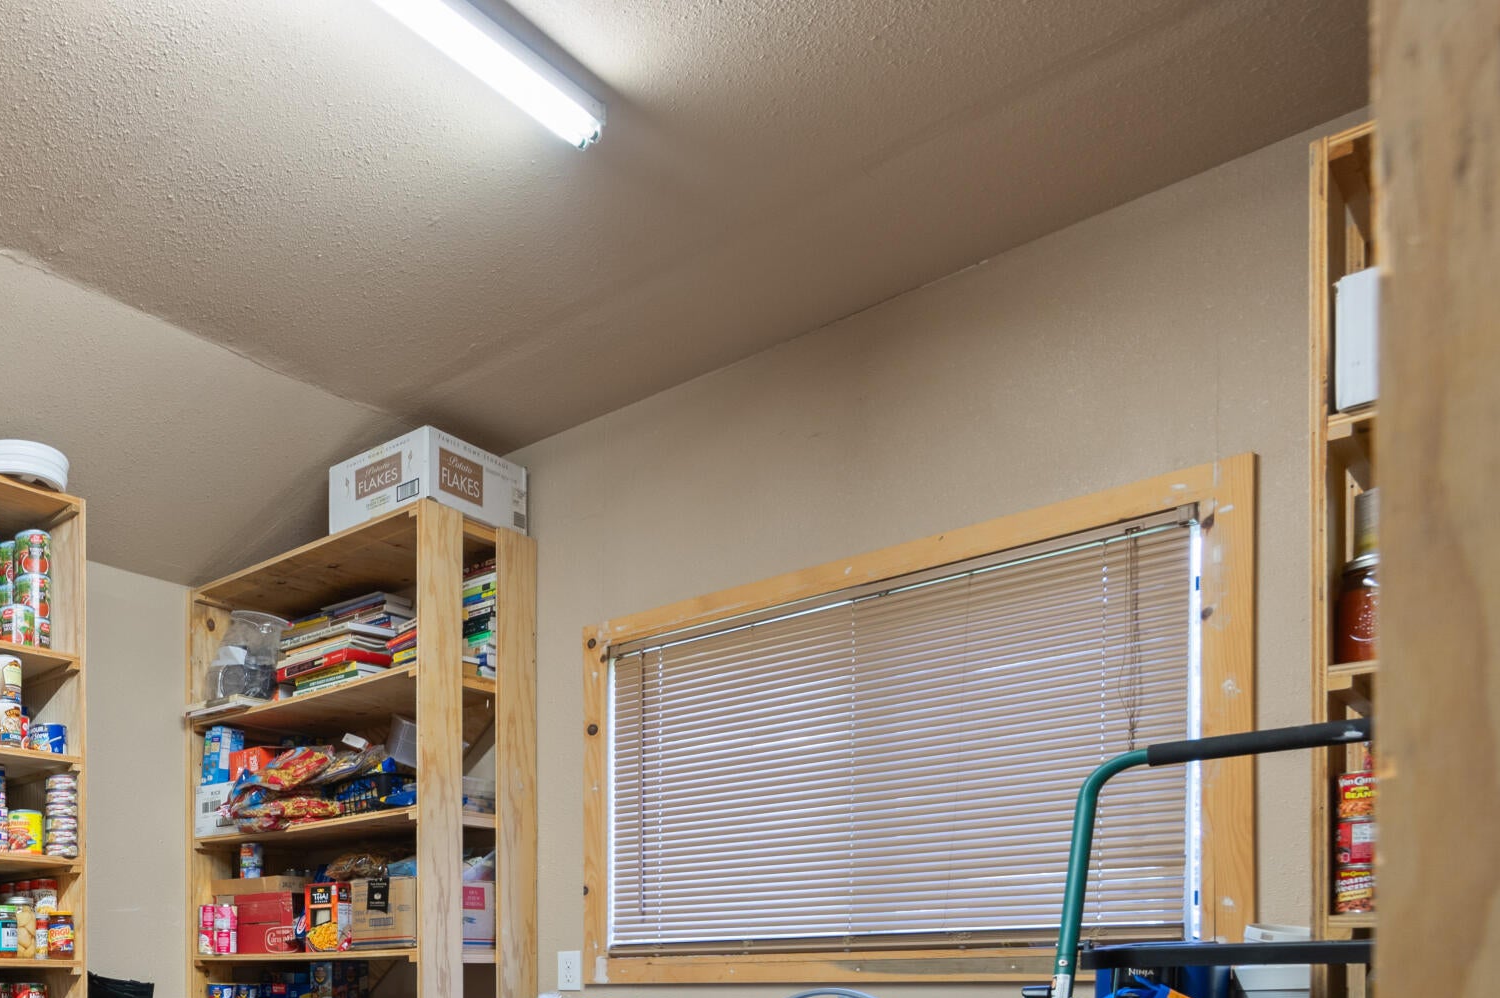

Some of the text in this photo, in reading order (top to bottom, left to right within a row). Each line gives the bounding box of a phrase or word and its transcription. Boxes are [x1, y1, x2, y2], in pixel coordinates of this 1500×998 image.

[438, 434, 460, 448] FAMILY
[449, 455, 472, 475] Potato
[358, 469, 398, 495] FLAKES
[441, 467, 480, 498] FLAKES
[1129, 968, 1154, 977] NINJA
